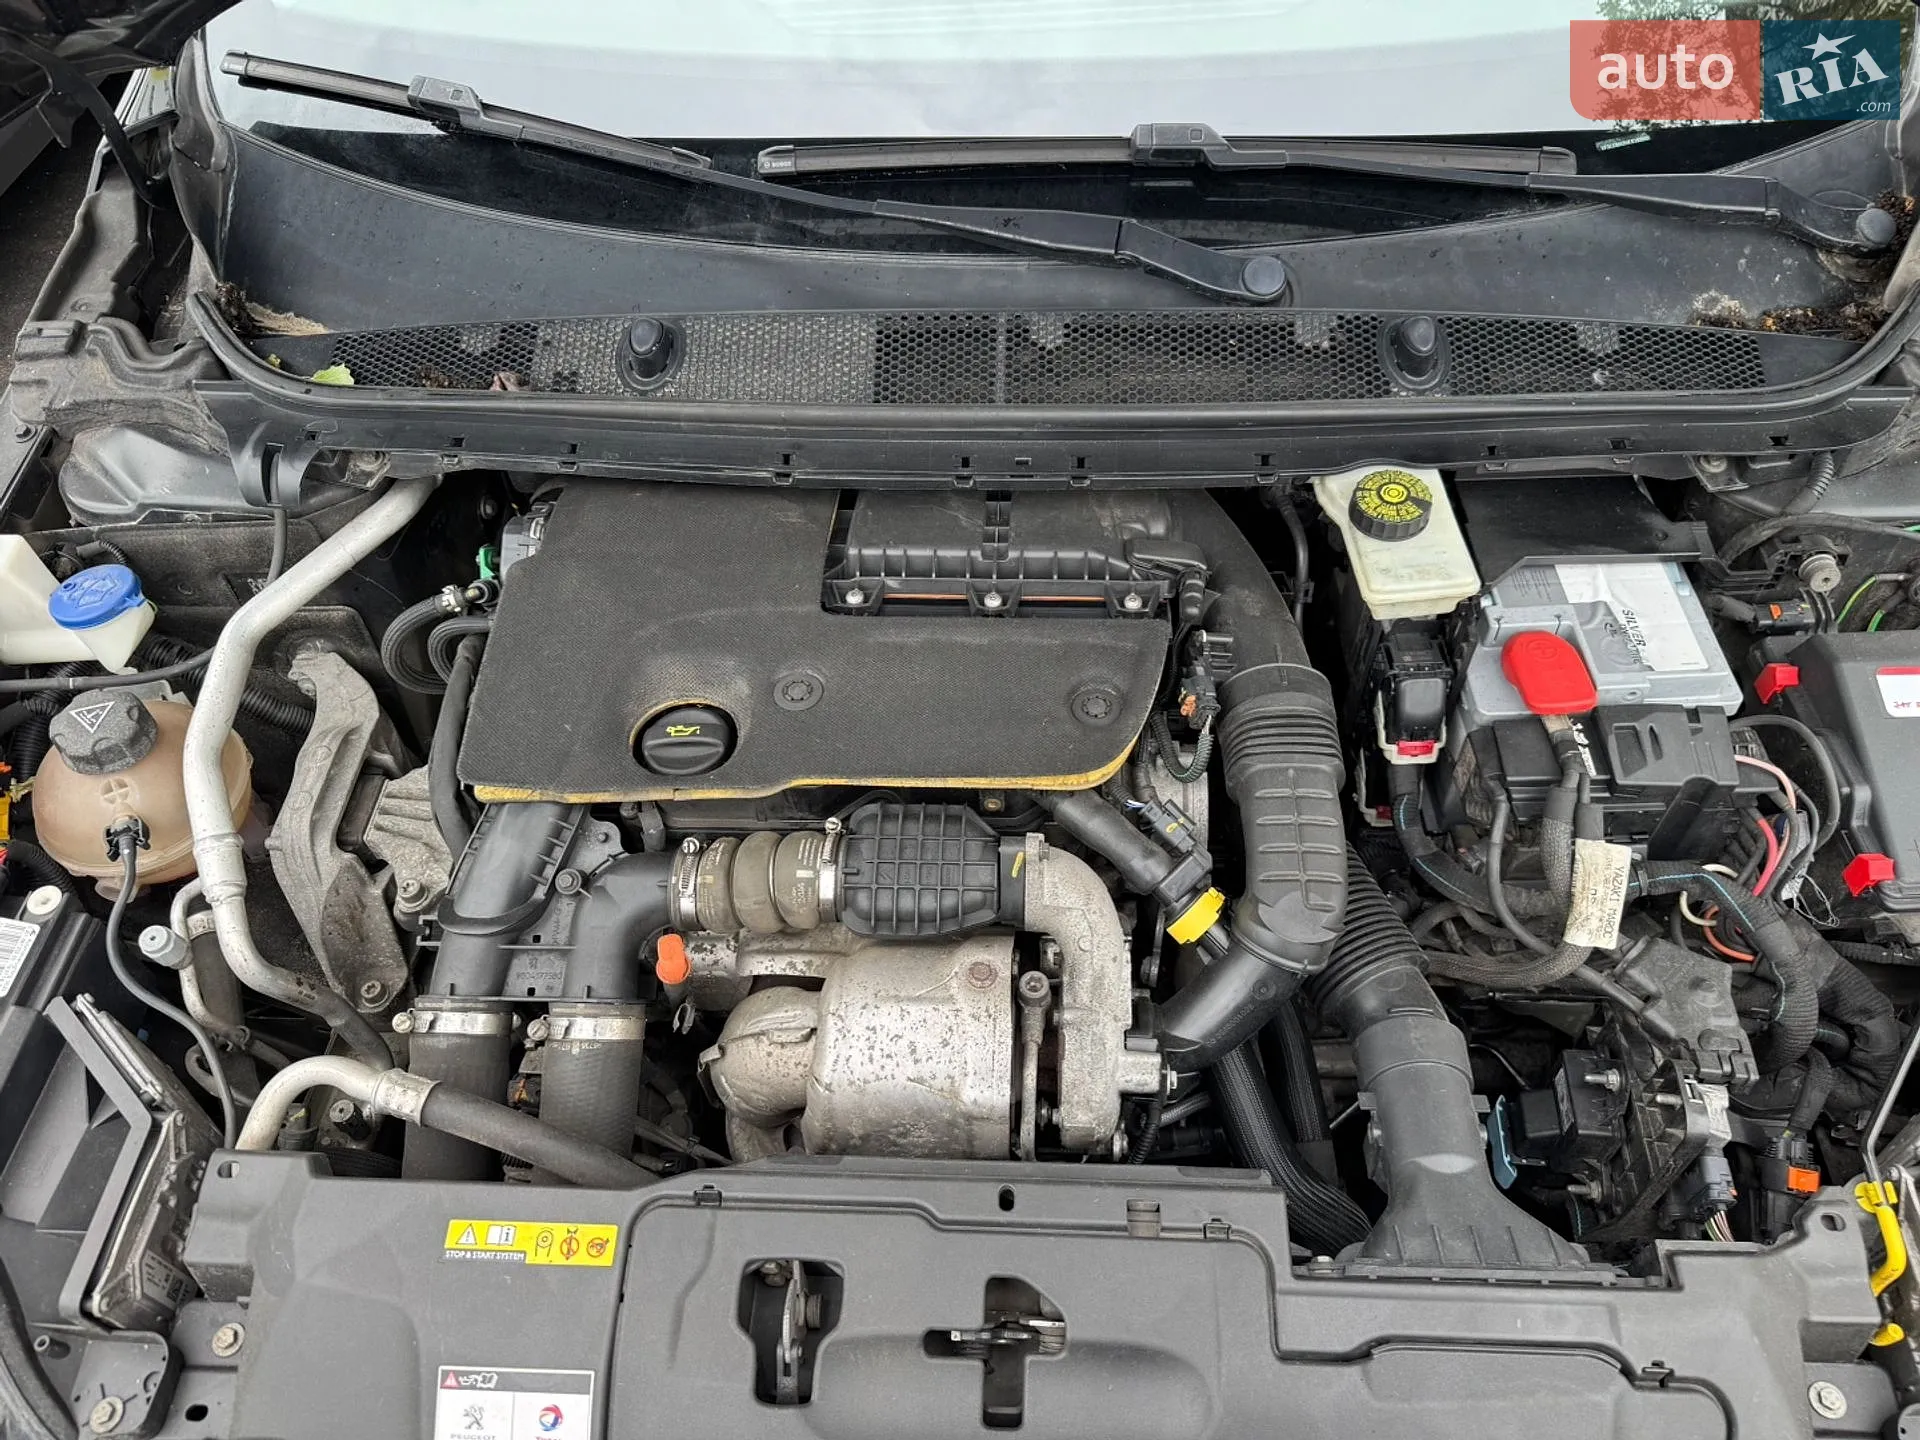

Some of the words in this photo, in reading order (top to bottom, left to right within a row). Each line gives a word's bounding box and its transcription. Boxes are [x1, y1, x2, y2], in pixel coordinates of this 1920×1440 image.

[1622, 609, 1647, 647] SILVER
[1609, 866, 1625, 903] YAZAKI
[1603, 908, 1617, 940] MAROC
[446, 1250, 465, 1259] STOP
[466, 1251, 471, 1259] &
[472, 1251, 495, 1260] START
[496, 1252, 525, 1261] SYSTEM
